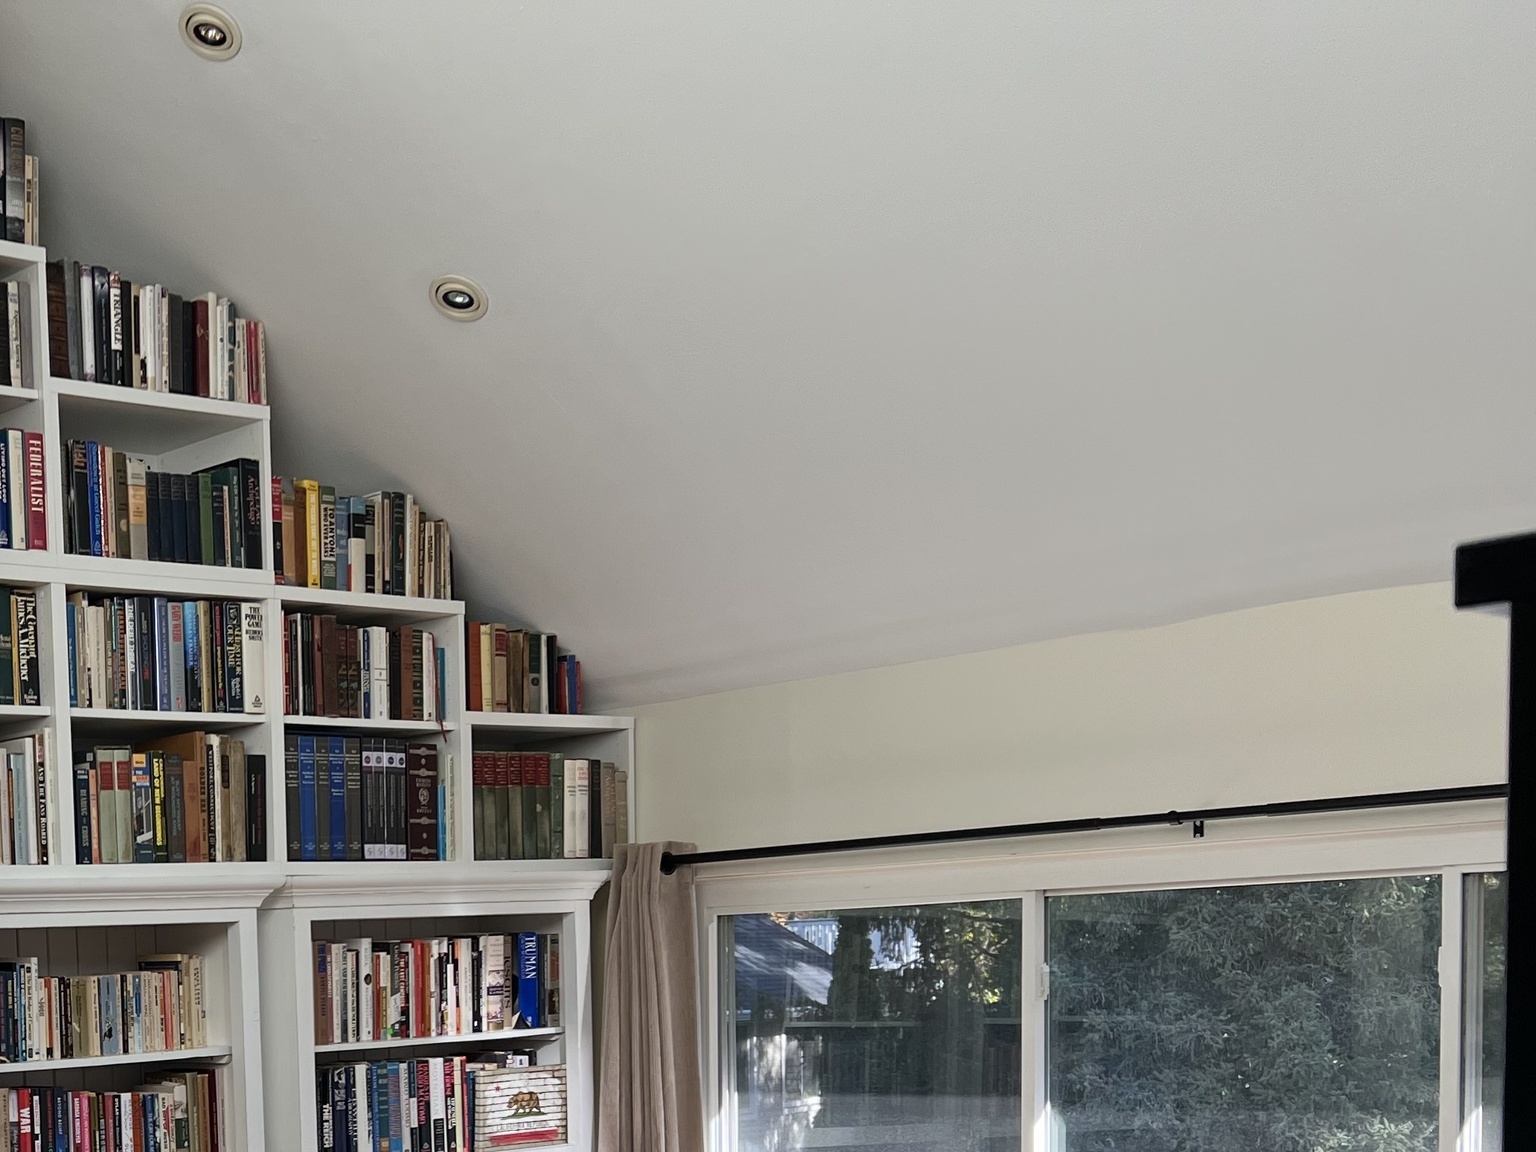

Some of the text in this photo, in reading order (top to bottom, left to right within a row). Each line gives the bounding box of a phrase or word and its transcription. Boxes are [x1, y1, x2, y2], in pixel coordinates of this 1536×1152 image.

[113, 293, 122, 345] TRIANGLE
[29, 440, 43, 513] FEDERALIST
[329, 507, 335, 519] TO
[15, 595, 26, 625] James
[171, 605, 181, 622] GARY
[26, 613, 37, 658] Covenant
[19, 638, 29, 681] Michener
[38, 783, 46, 797] THE
[155, 805, 163, 846] BEGINNINGS
[524, 936, 537, 979] TRUMAN
[19, 1107, 31, 1134] WAR
[322, 1103, 331, 1148] THE REICH
